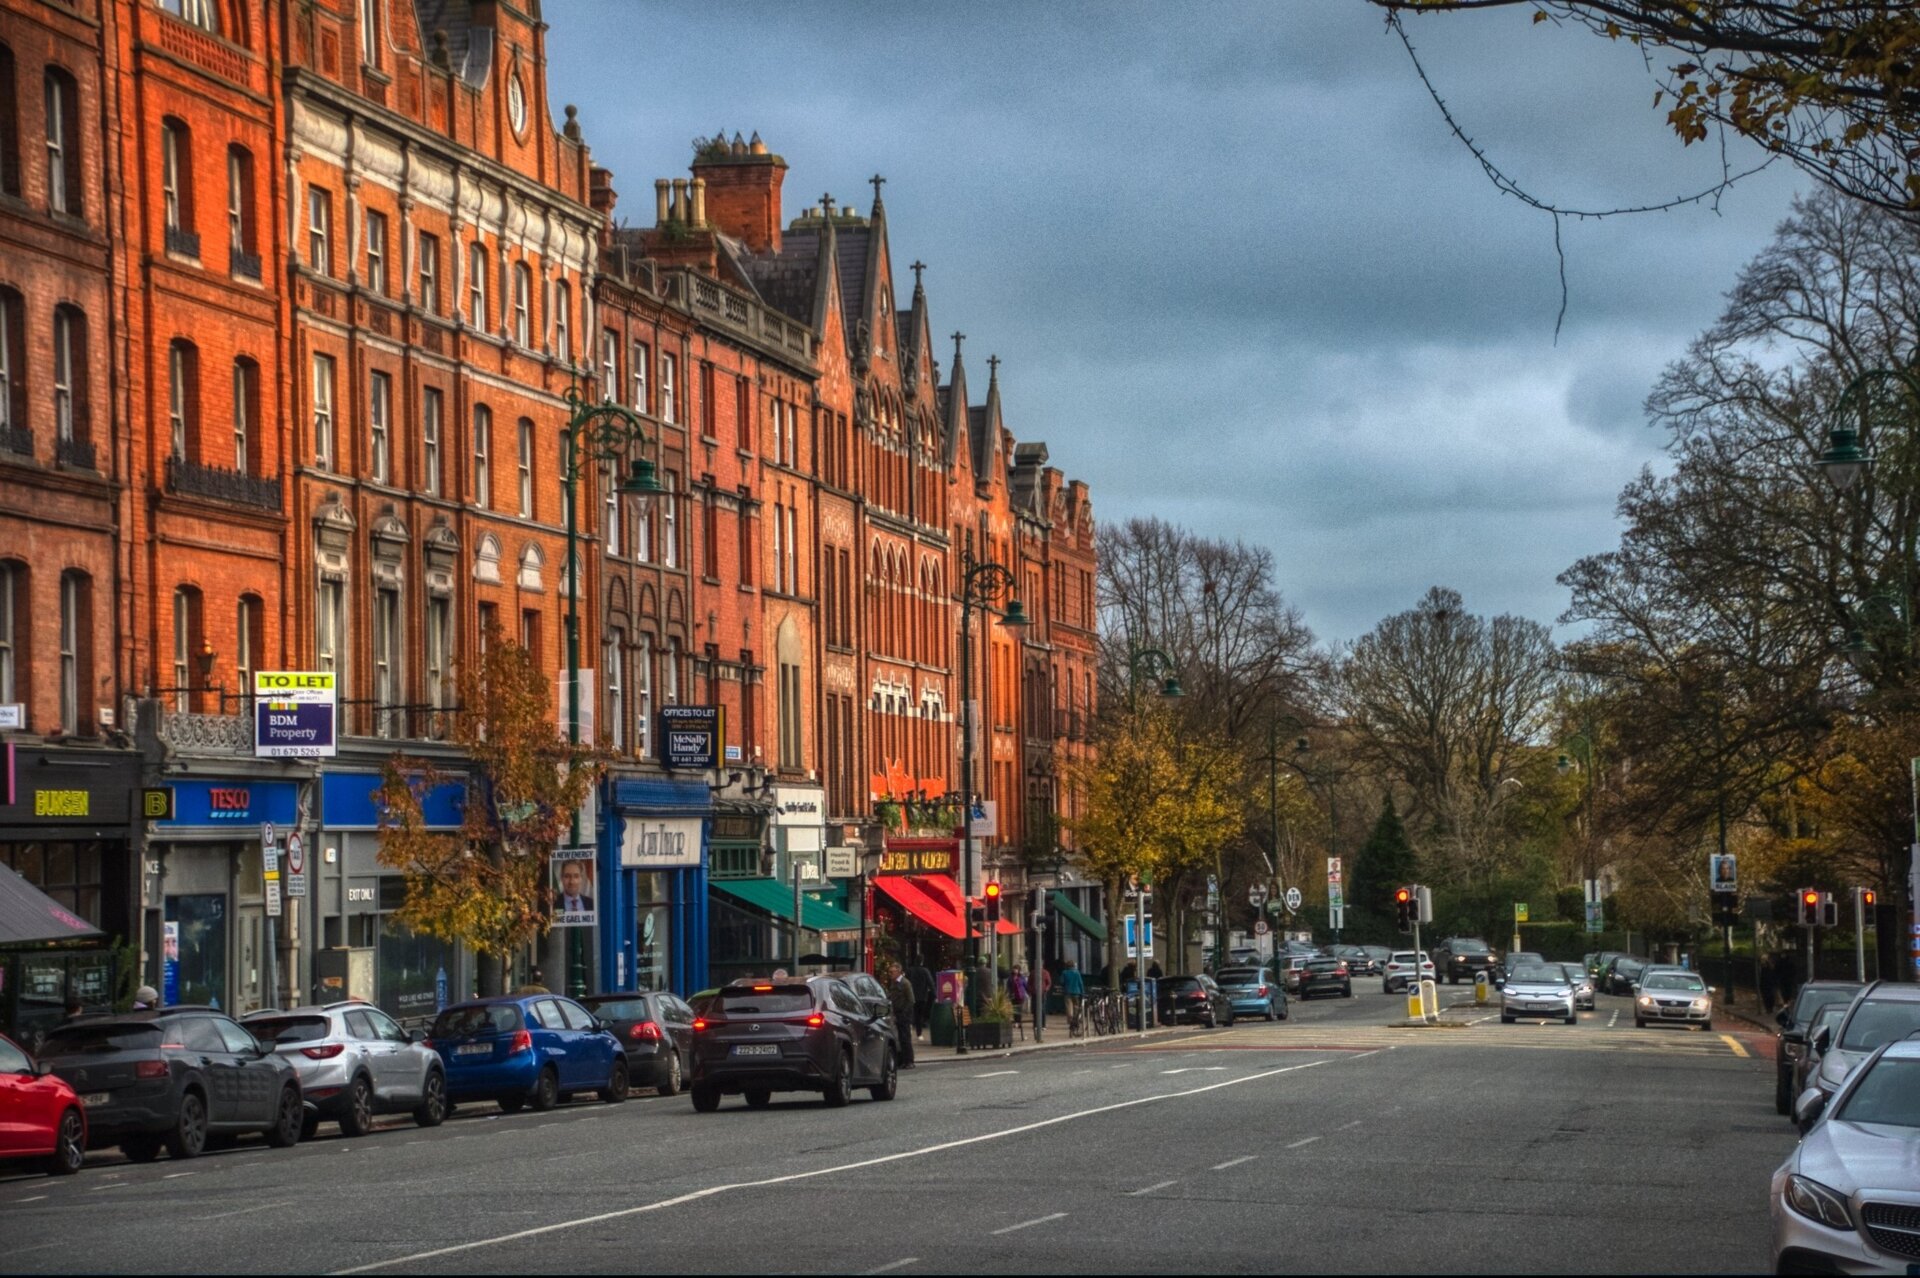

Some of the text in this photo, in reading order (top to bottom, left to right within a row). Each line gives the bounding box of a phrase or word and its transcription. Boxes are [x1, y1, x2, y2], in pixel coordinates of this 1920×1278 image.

[262, 675, 330, 687] TO LET
[663, 709, 716, 717] OFFICES TO LET
[269, 715, 298, 726] BDM
[269, 728, 317, 740] Property
[673, 735, 707, 745] McNally
[673, 745, 701, 753] Handy
[35, 790, 89, 816] BUNSEN
[144, 792, 167, 816] B
[210, 788, 250, 809] TESCO
[571, 850, 593, 858] ENERGY
[348, 888, 375, 901] EXIT ONLY
[566, 915, 581, 923] GAEL
